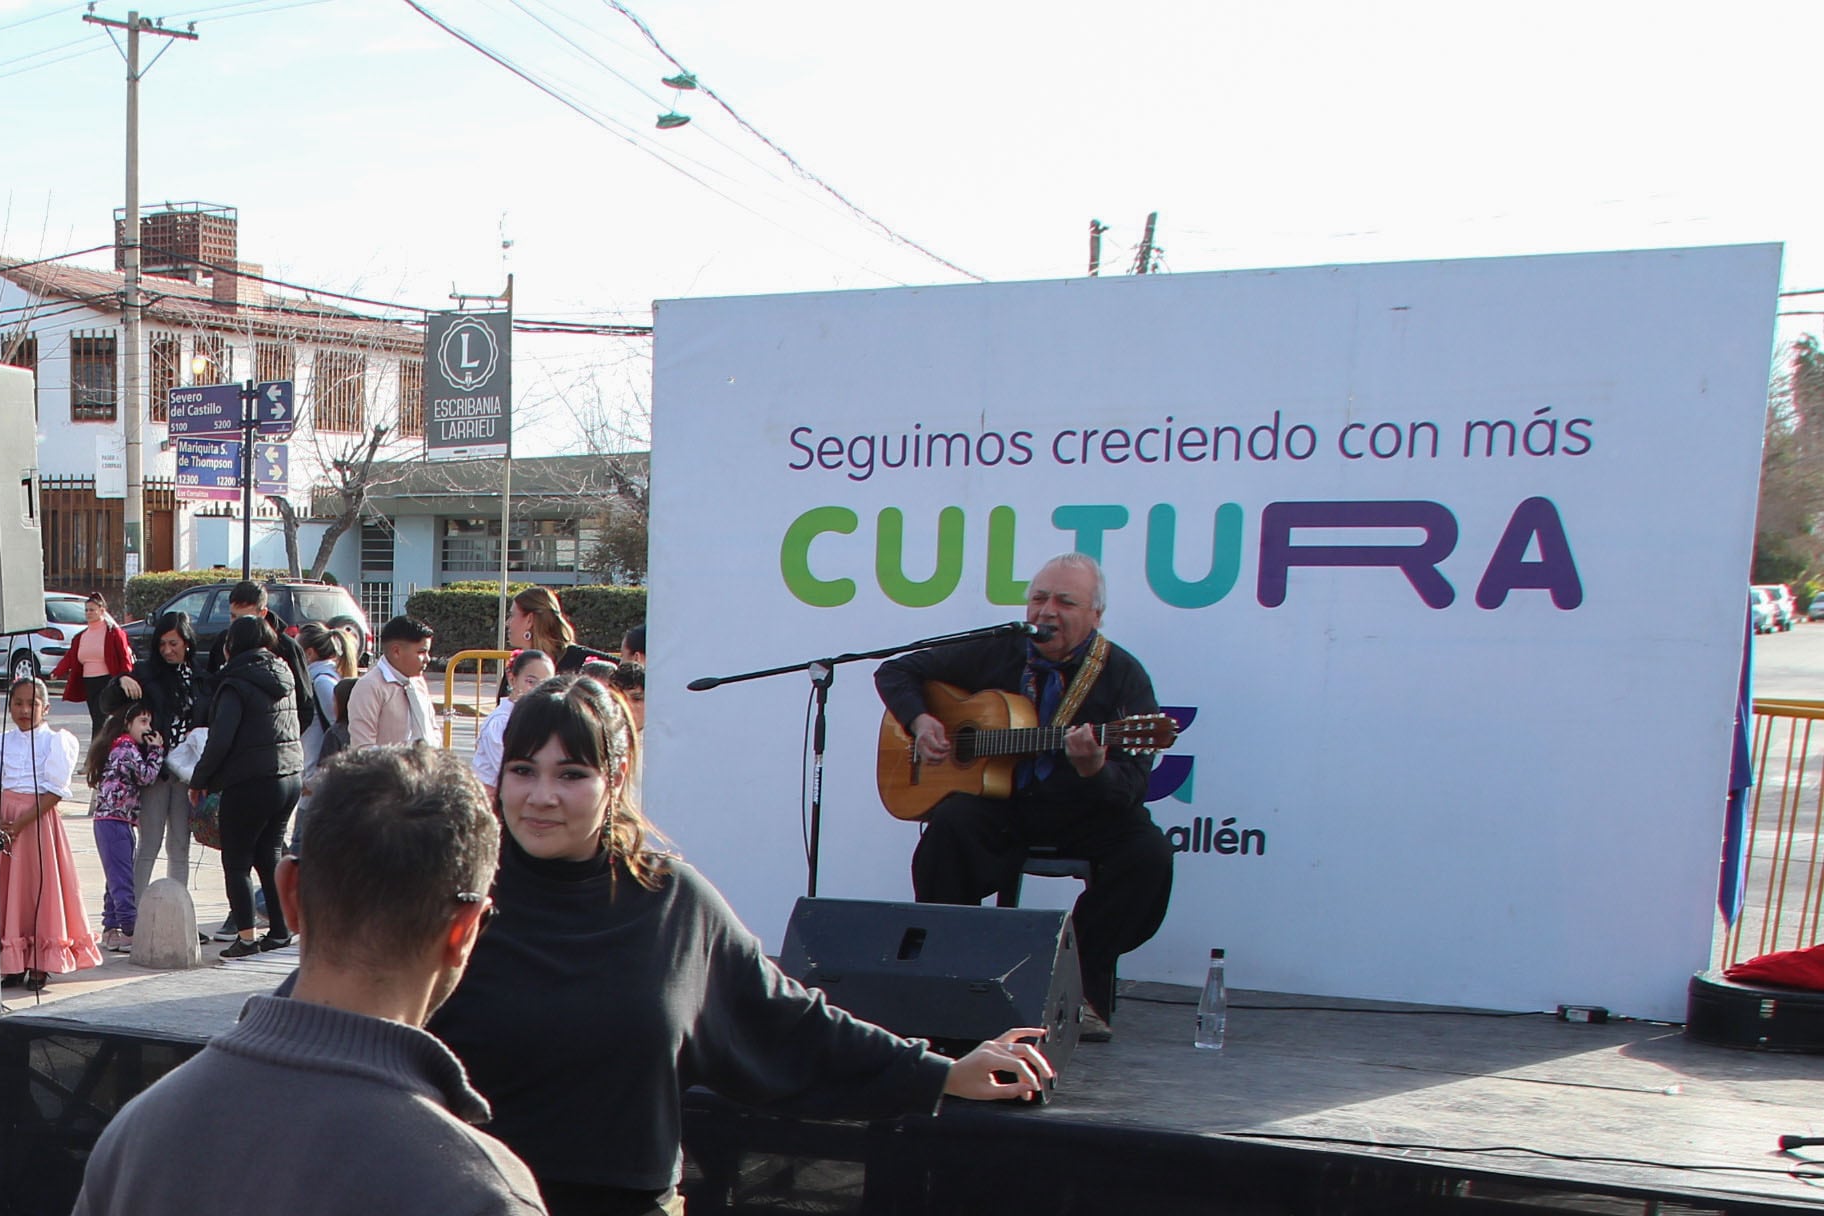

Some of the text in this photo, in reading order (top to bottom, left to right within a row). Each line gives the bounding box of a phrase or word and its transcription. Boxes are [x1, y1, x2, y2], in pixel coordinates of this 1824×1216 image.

[170, 392, 202, 403] Severo
[170, 403, 222, 417] del Castillo
[434, 396, 502, 418] ESCRIBANIA
[170, 420, 232, 432] 5100 5200
[441, 419, 495, 441] LARRIEU
[179, 441, 228, 456] Mariquita S.
[788, 406, 1594, 481] Seguimos creciendo con más
[178, 455, 233, 471] de Thompson
[178, 474, 237, 487] 12300 12200
[780, 495, 1585, 611] CULTURA
